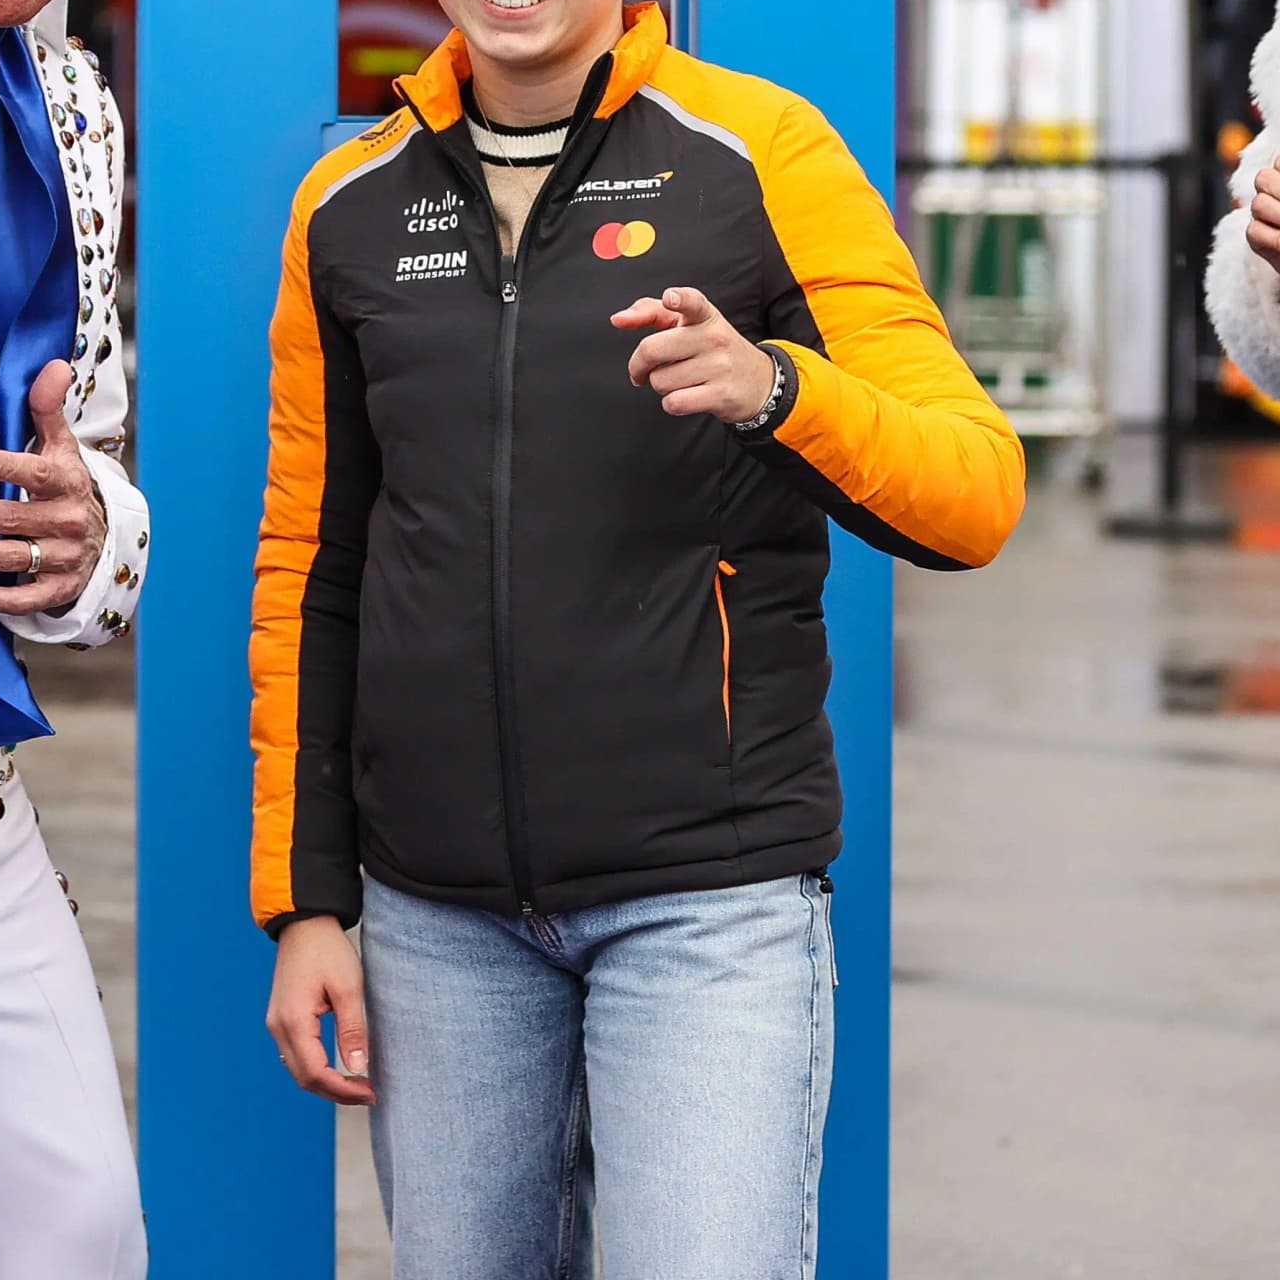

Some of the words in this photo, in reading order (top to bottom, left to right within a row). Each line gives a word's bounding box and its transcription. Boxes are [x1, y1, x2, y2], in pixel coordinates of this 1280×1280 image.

[407, 213, 458, 233] CISCO
[396, 250, 468, 273] RODIN
[395, 268, 467, 282] MOTORSPORT
